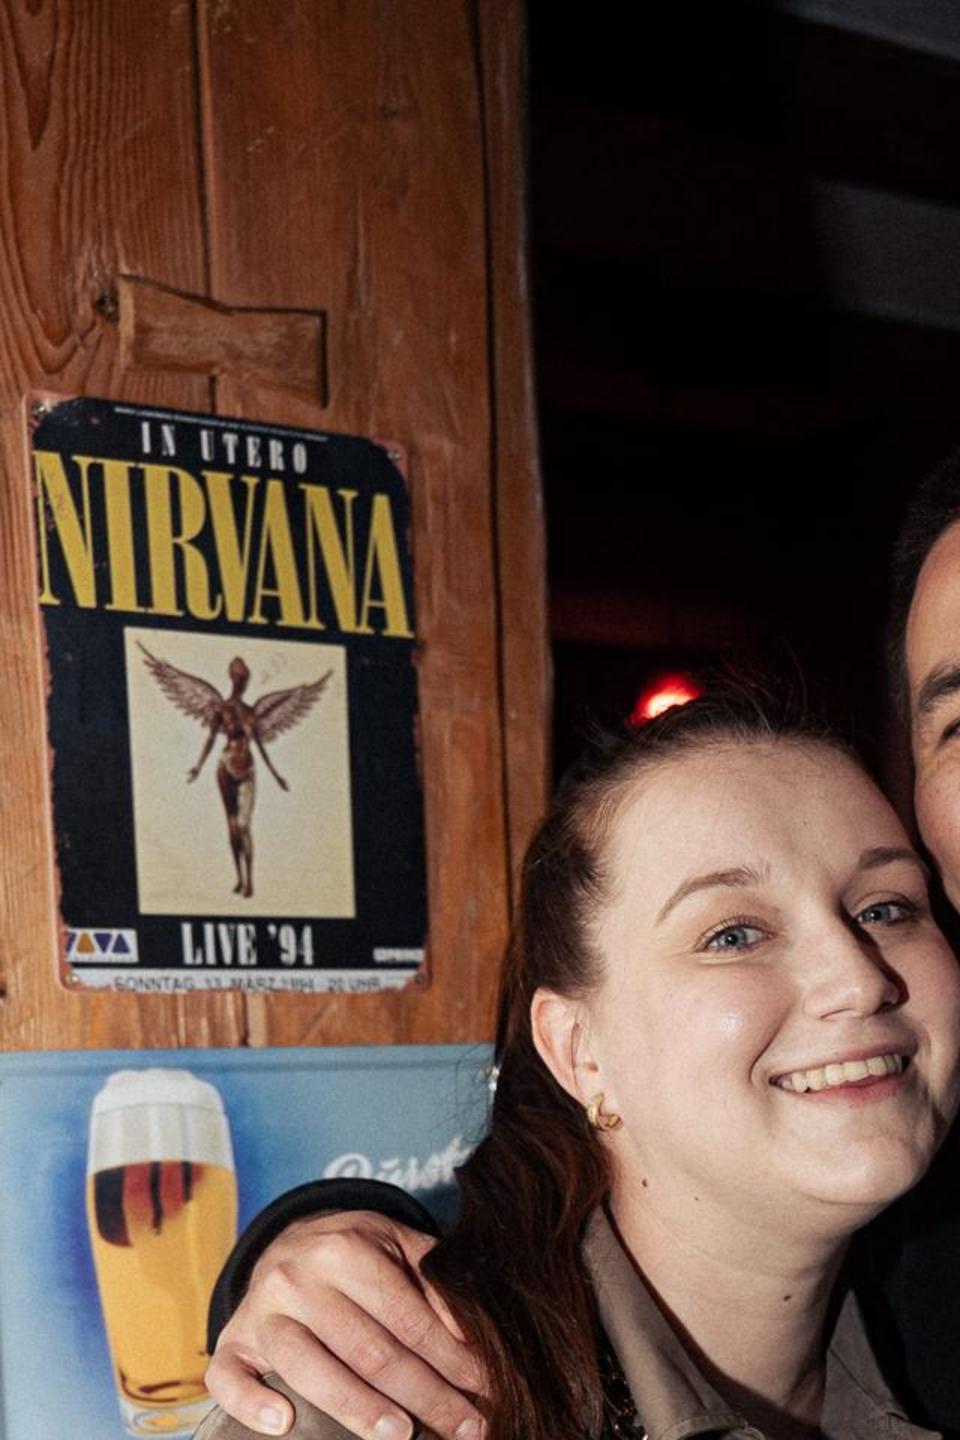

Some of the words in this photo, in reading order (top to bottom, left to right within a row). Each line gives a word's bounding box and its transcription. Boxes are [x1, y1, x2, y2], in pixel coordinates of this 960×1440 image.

[141, 421, 176, 457] IN
[200, 429, 308, 475] UTERO
[32, 450, 415, 639] NIRVANA
[181, 922, 258, 966] LIVE
[114, 976, 195, 992] SONNTAG
